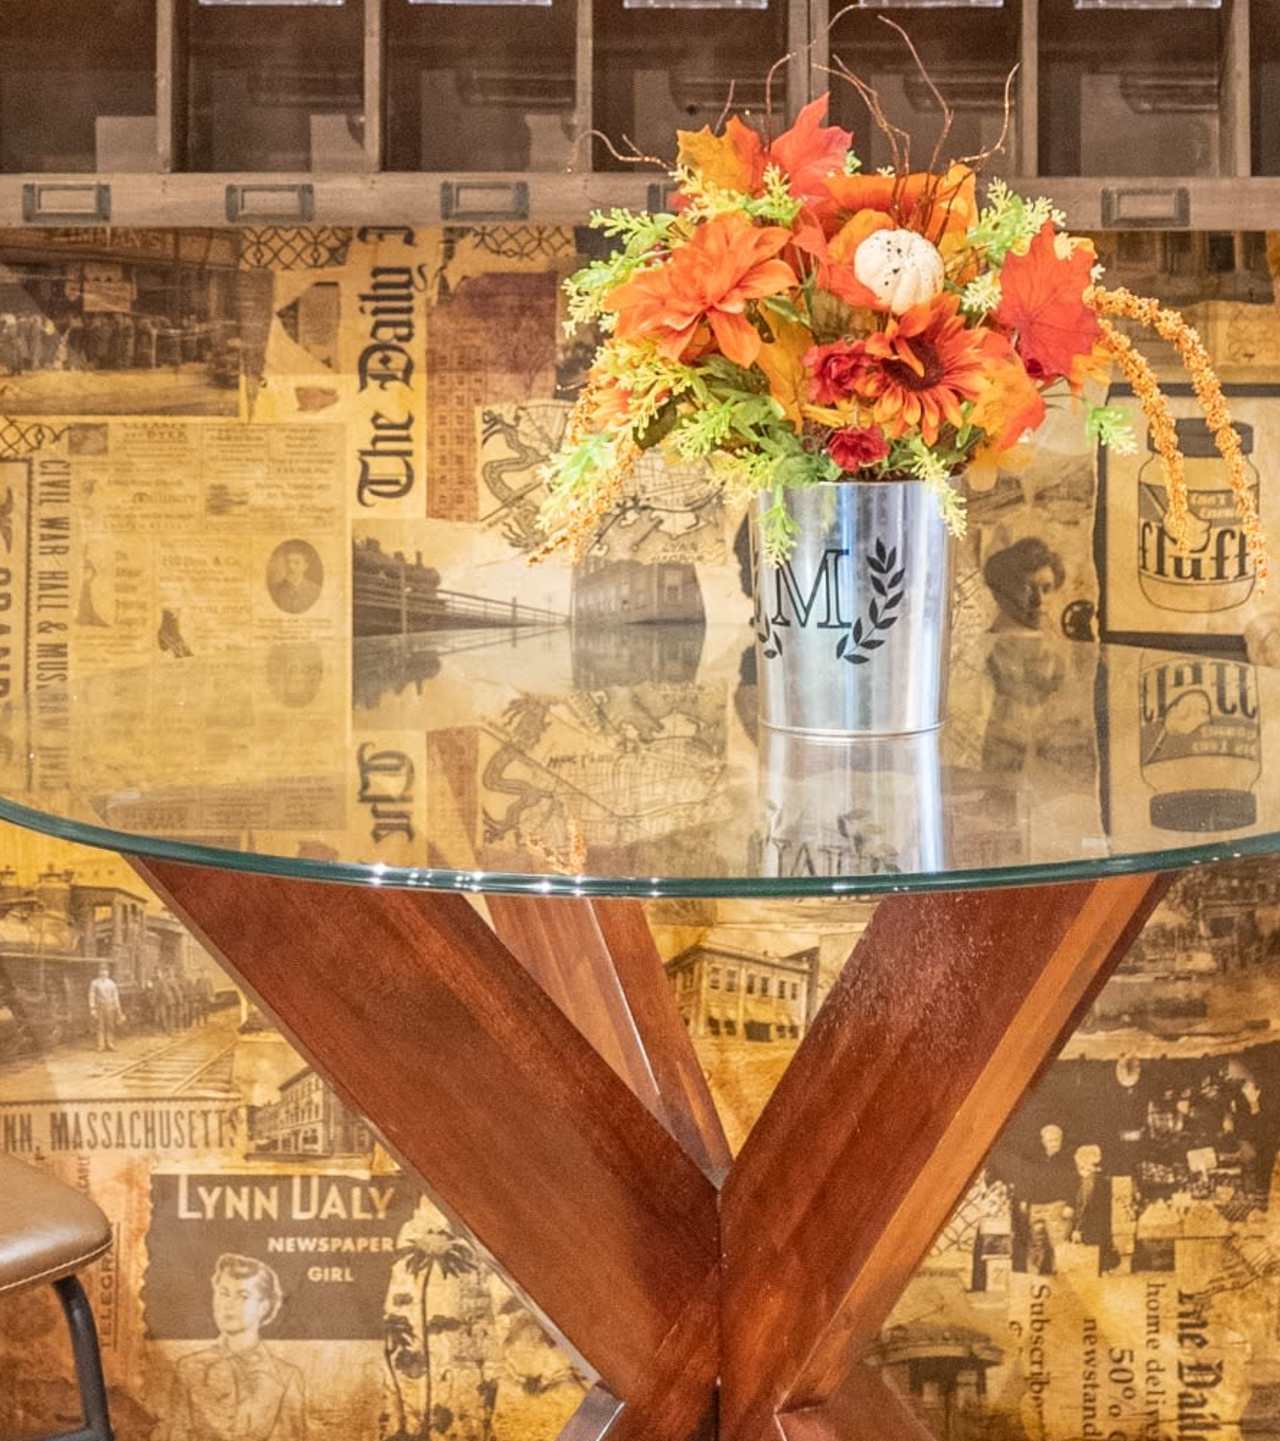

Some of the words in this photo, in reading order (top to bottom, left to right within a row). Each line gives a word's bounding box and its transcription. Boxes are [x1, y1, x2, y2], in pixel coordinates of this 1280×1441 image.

[356, 264, 422, 394] Daily
[37, 458, 71, 507] CIVIL
[356, 413, 415, 507] The
[37, 515, 71, 556] WAR
[36, 569, 70, 613] HALL
[36, 620, 69, 635] &
[49, 1106, 243, 1151] MASSACHUSETTS
[177, 1173, 279, 1221] LYNN
[291, 1173, 395, 1221] DALY
[267, 1236, 396, 1254] NEWSPAPER
[307, 1266, 354, 1284] GIRL
[1145, 1282, 1167, 1351] home
[1081, 1318, 1103, 1440] newstand
[1107, 1347, 1137, 1419] 50%
